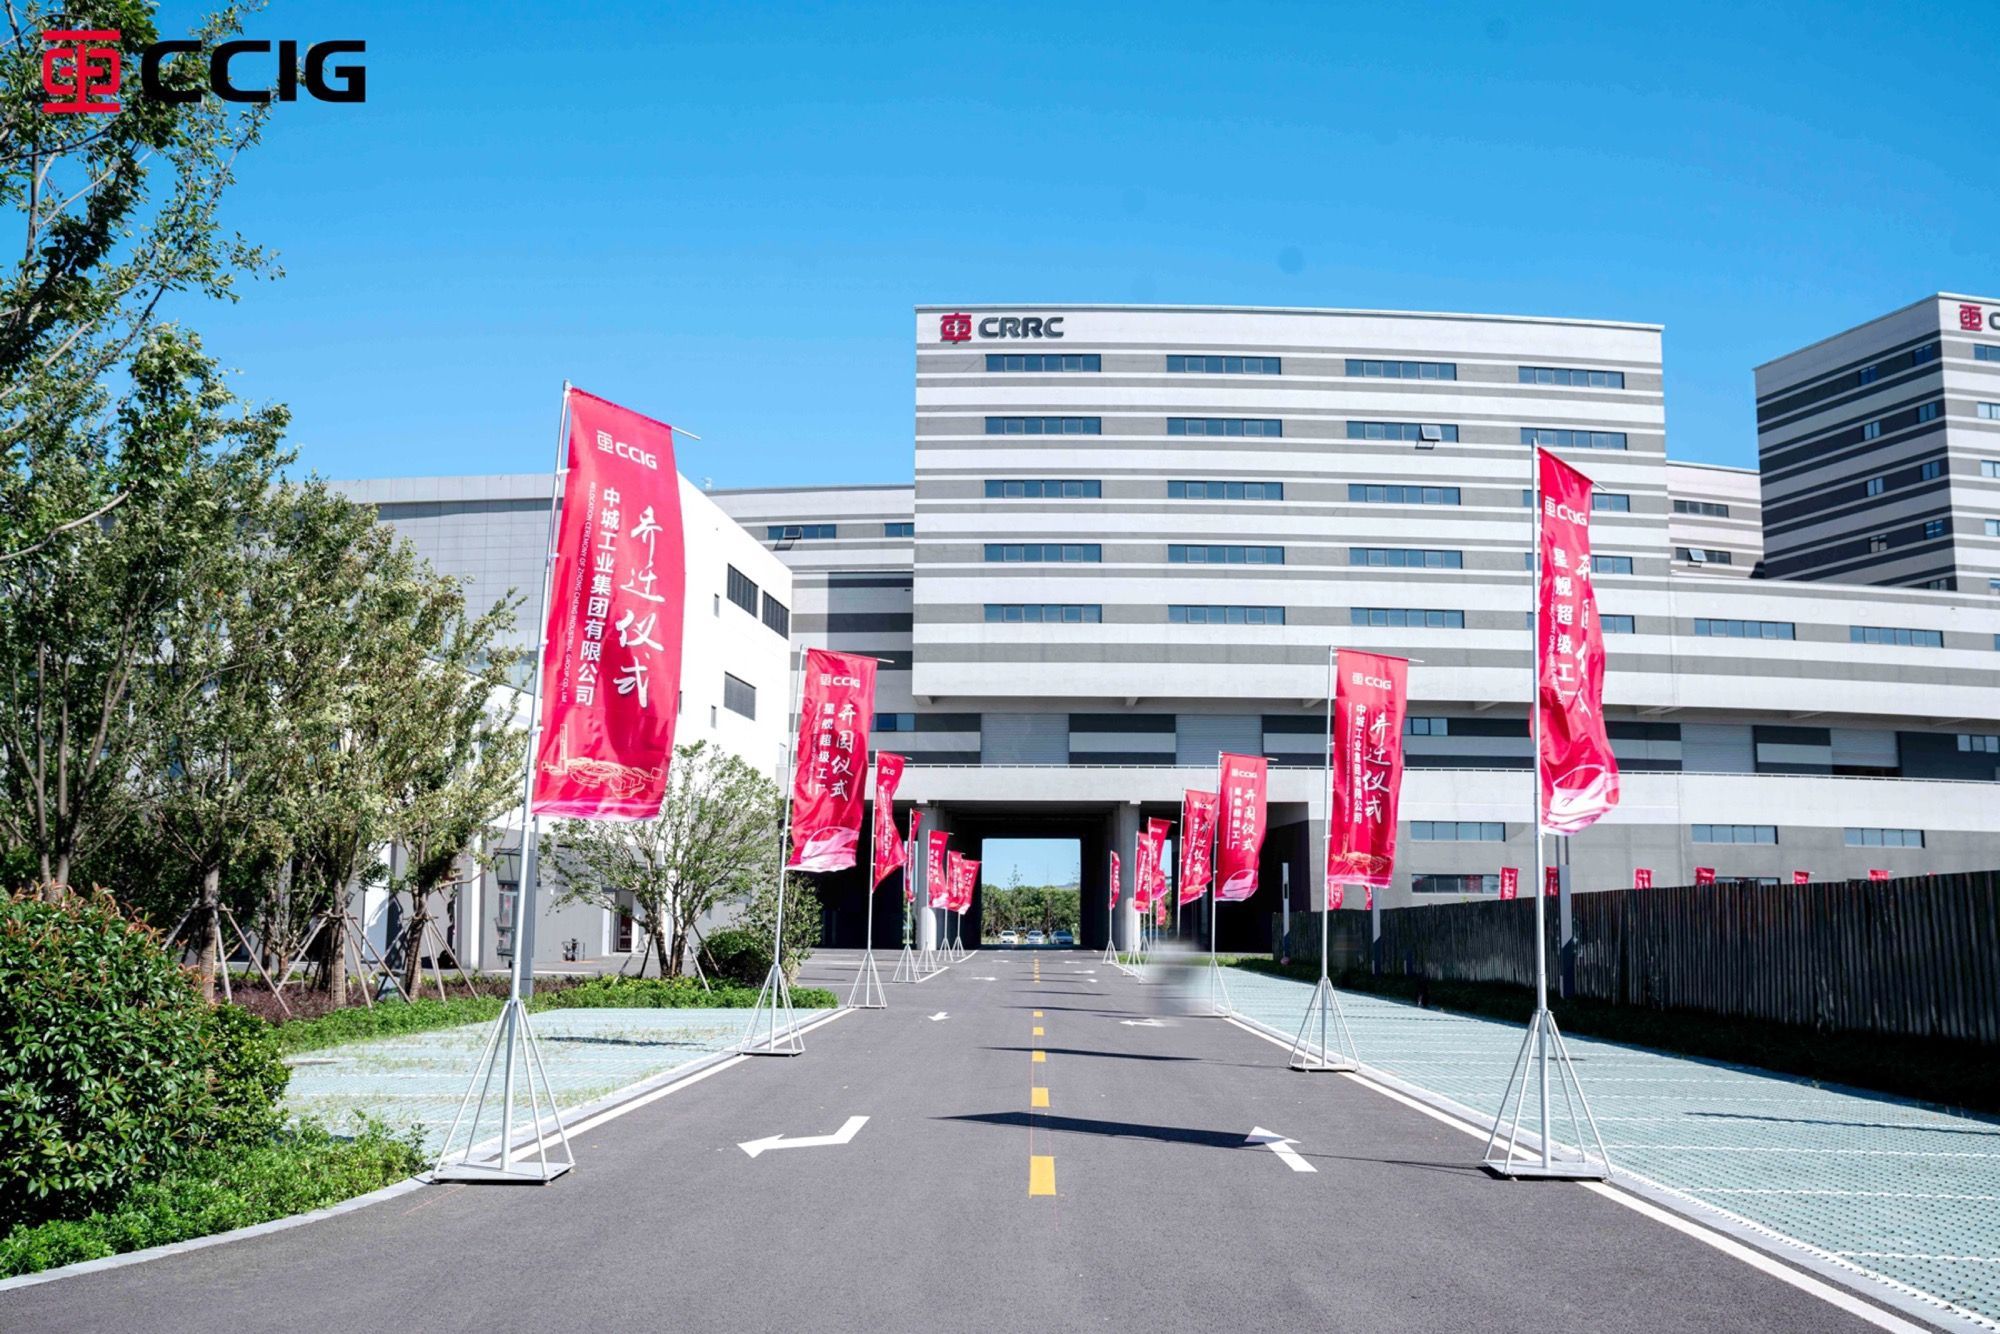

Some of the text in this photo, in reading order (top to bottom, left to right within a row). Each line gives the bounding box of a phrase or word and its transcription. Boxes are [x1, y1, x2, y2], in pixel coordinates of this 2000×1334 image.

[978, 316, 1065, 339] CRRC
[615, 441, 658, 470] CCIG
[575, 487, 621, 706] 中城工业集团有限公司
